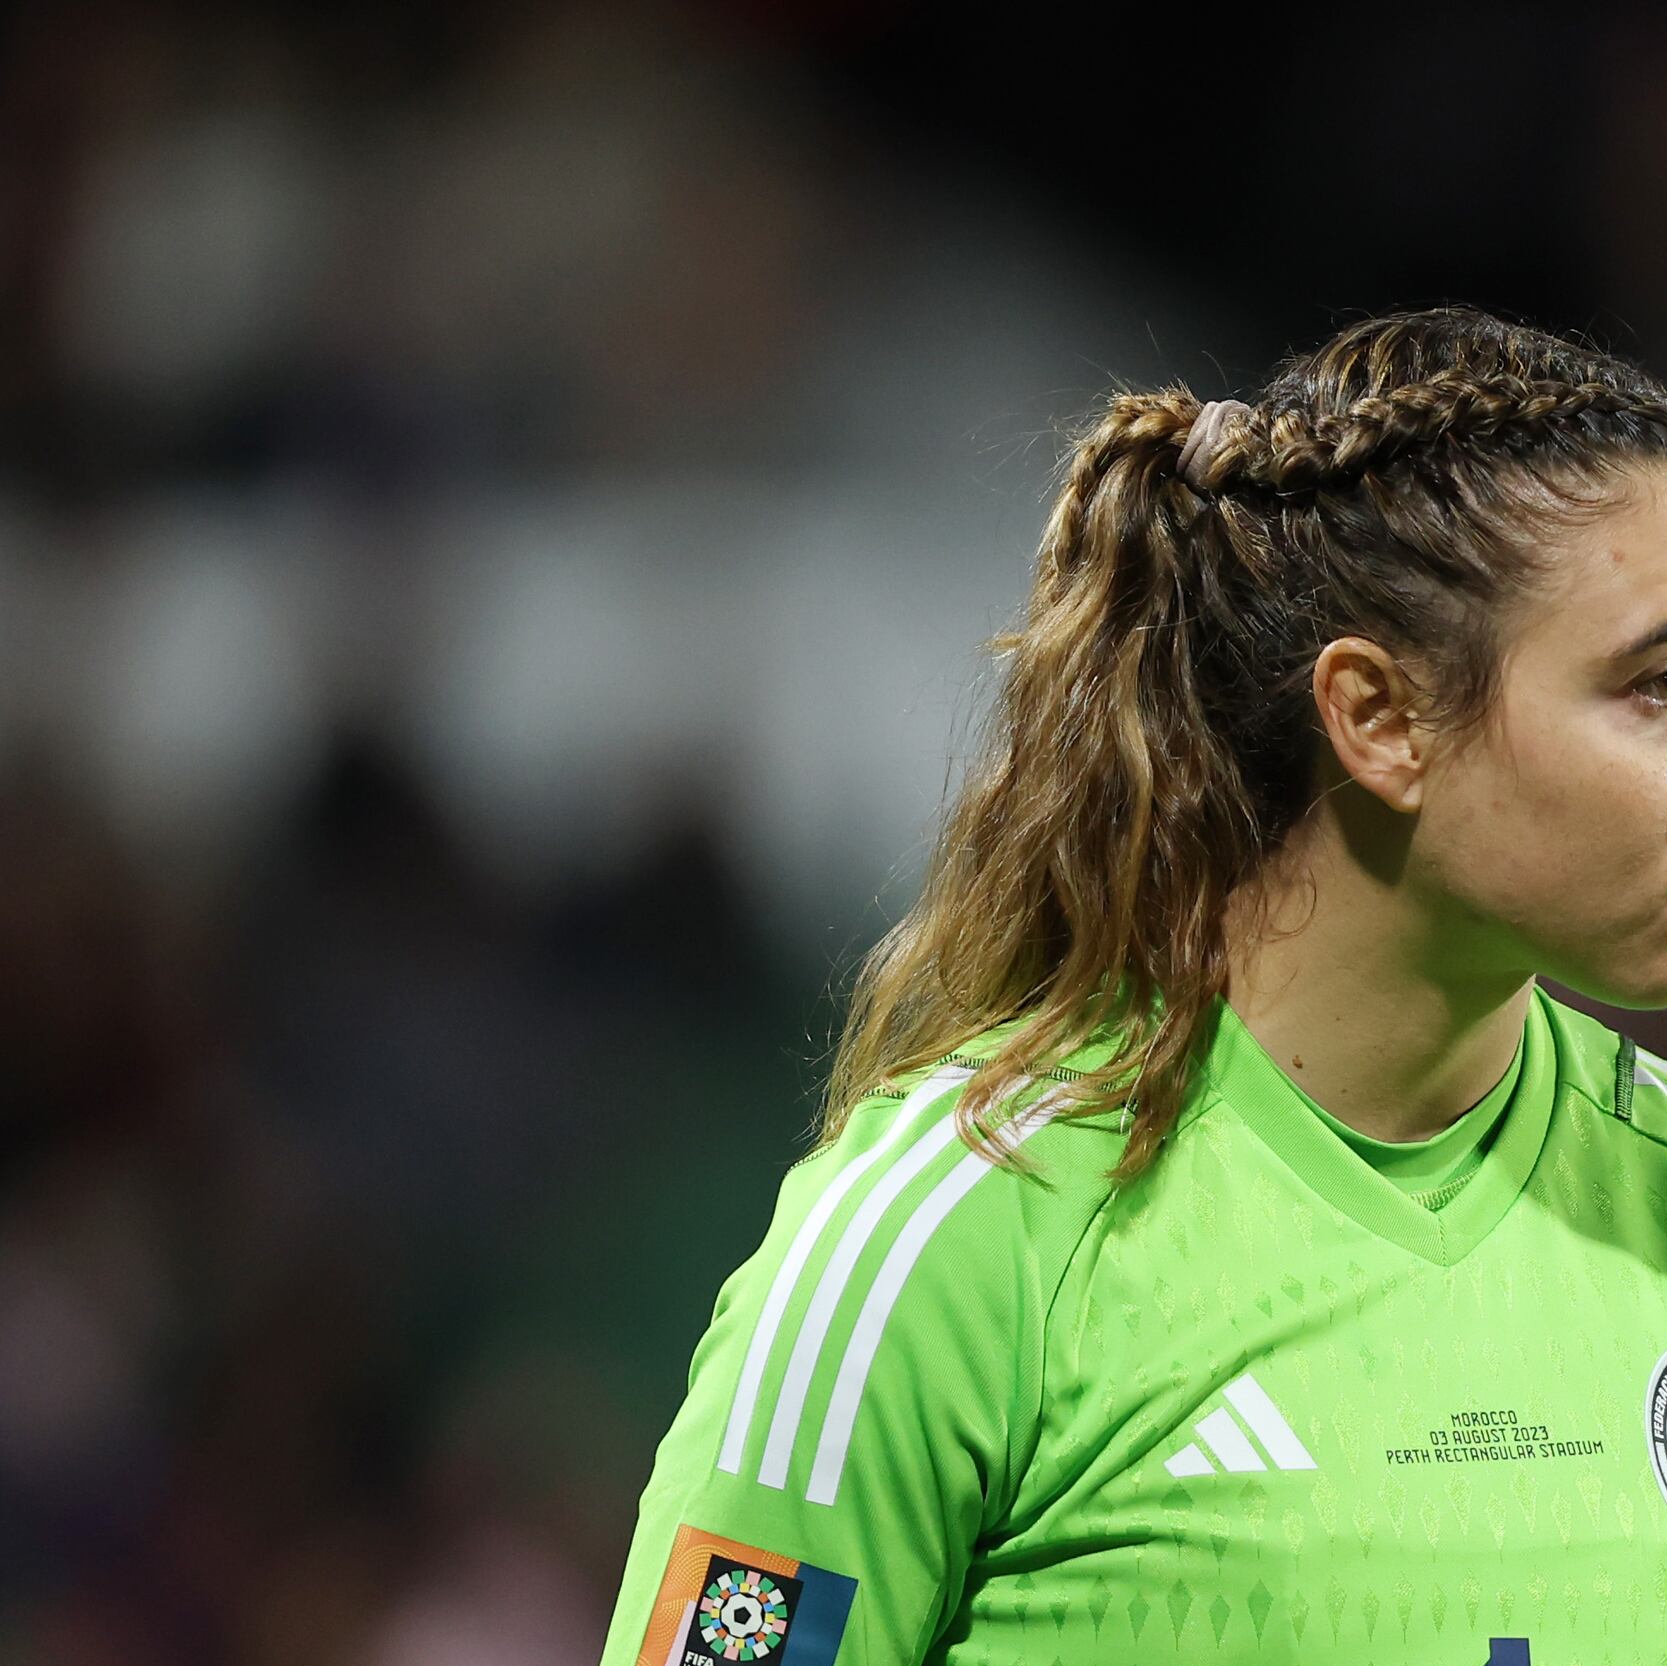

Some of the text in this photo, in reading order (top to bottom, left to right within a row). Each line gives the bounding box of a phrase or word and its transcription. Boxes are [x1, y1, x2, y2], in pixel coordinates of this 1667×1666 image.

[1451, 1410, 1518, 1428] MOROCCO
[1429, 1425, 1549, 1446] 03 AUGUST 2023
[1386, 1440, 1605, 1465] PERTH RECTANGULAR STADIUM
